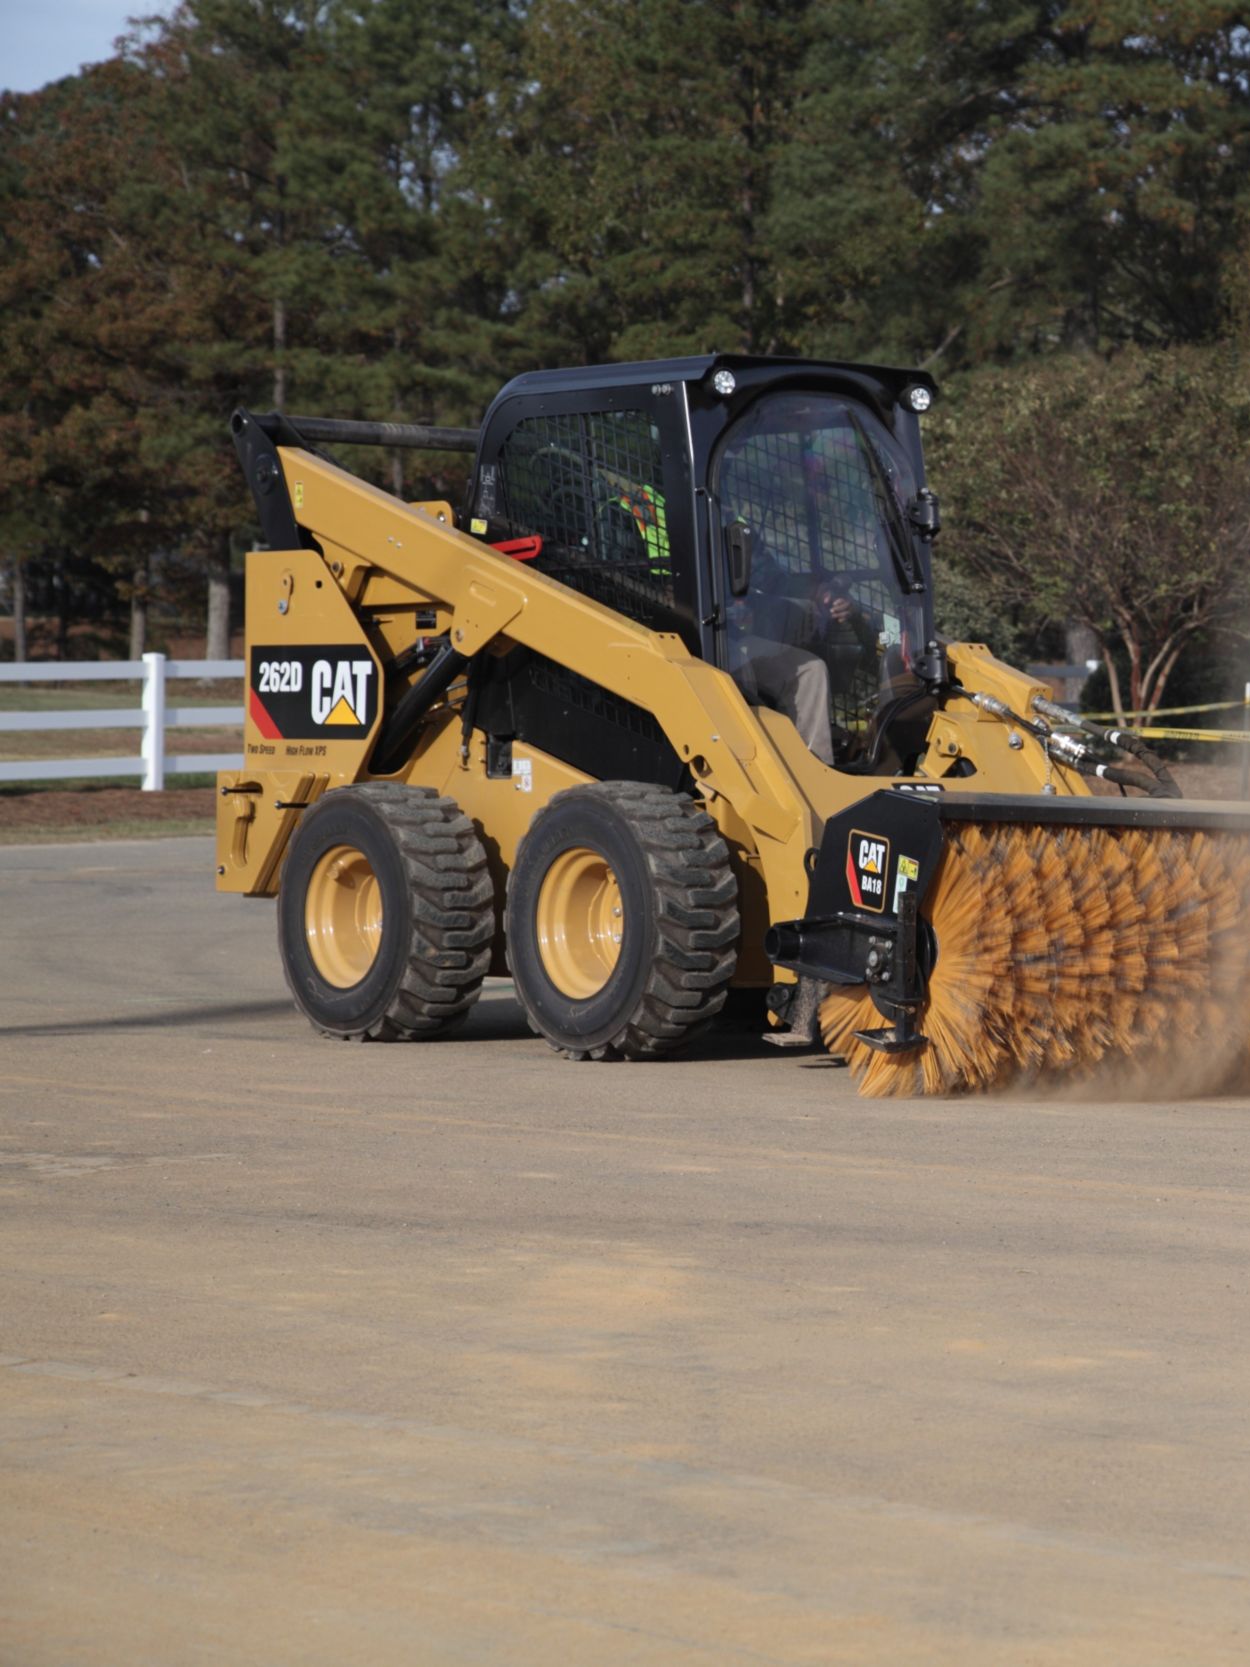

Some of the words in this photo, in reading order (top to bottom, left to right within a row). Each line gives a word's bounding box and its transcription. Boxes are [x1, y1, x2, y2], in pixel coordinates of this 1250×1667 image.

[259, 661, 303, 692] 262D
[311, 659, 373, 725] CAT
[859, 839, 886, 874] CAT
[861, 875, 882, 895] BA18
